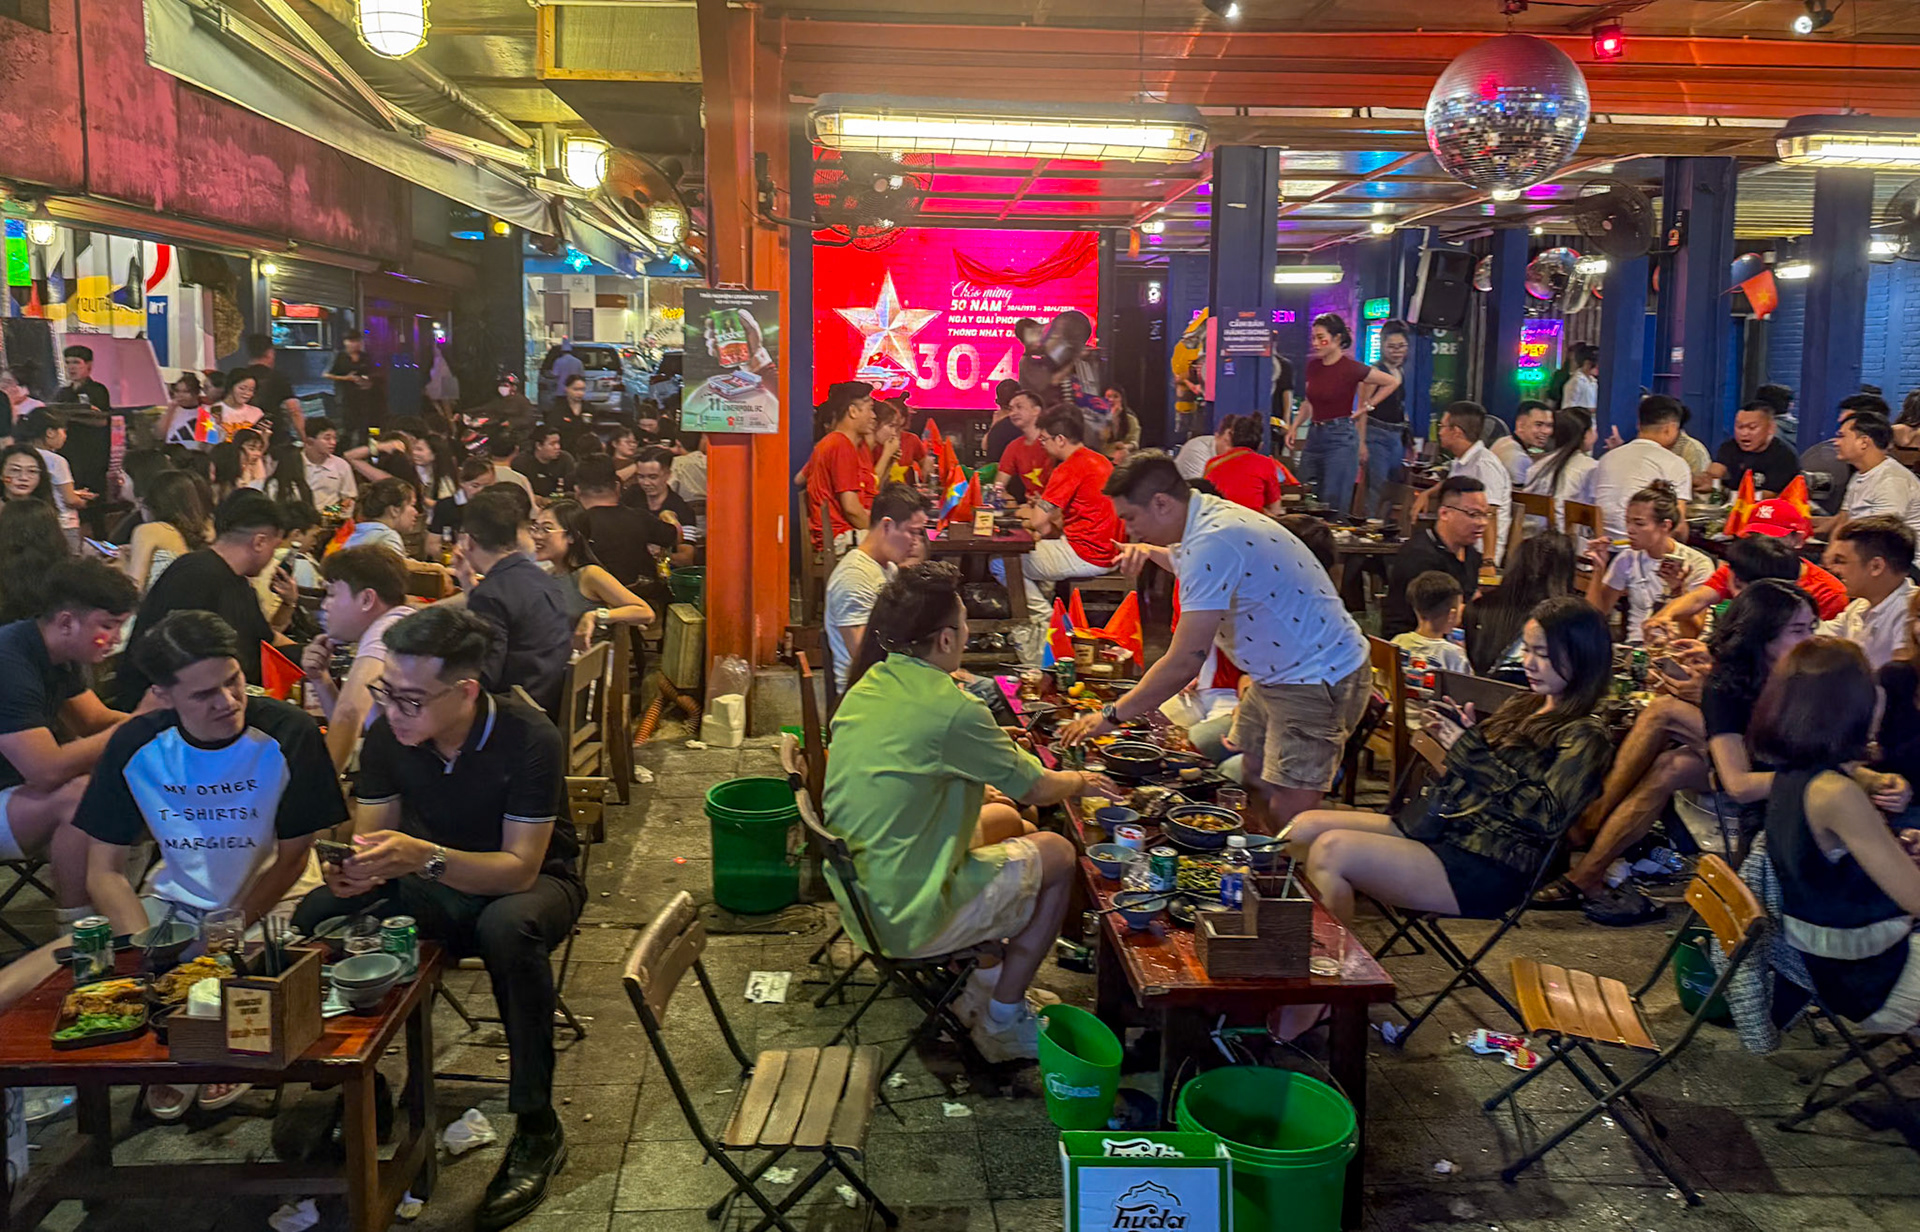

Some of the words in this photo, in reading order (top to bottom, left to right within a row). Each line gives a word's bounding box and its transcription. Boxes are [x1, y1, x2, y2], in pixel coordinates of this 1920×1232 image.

[951, 280, 982, 298] Chào
[949, 300, 967, 311] 50
[969, 298, 1003, 312] NĂM
[163, 784, 187, 795] MY
[196, 779, 259, 796] OTHER
[164, 836, 257, 851] MARGIELA
[1112, 1204, 1188, 1229] huda
